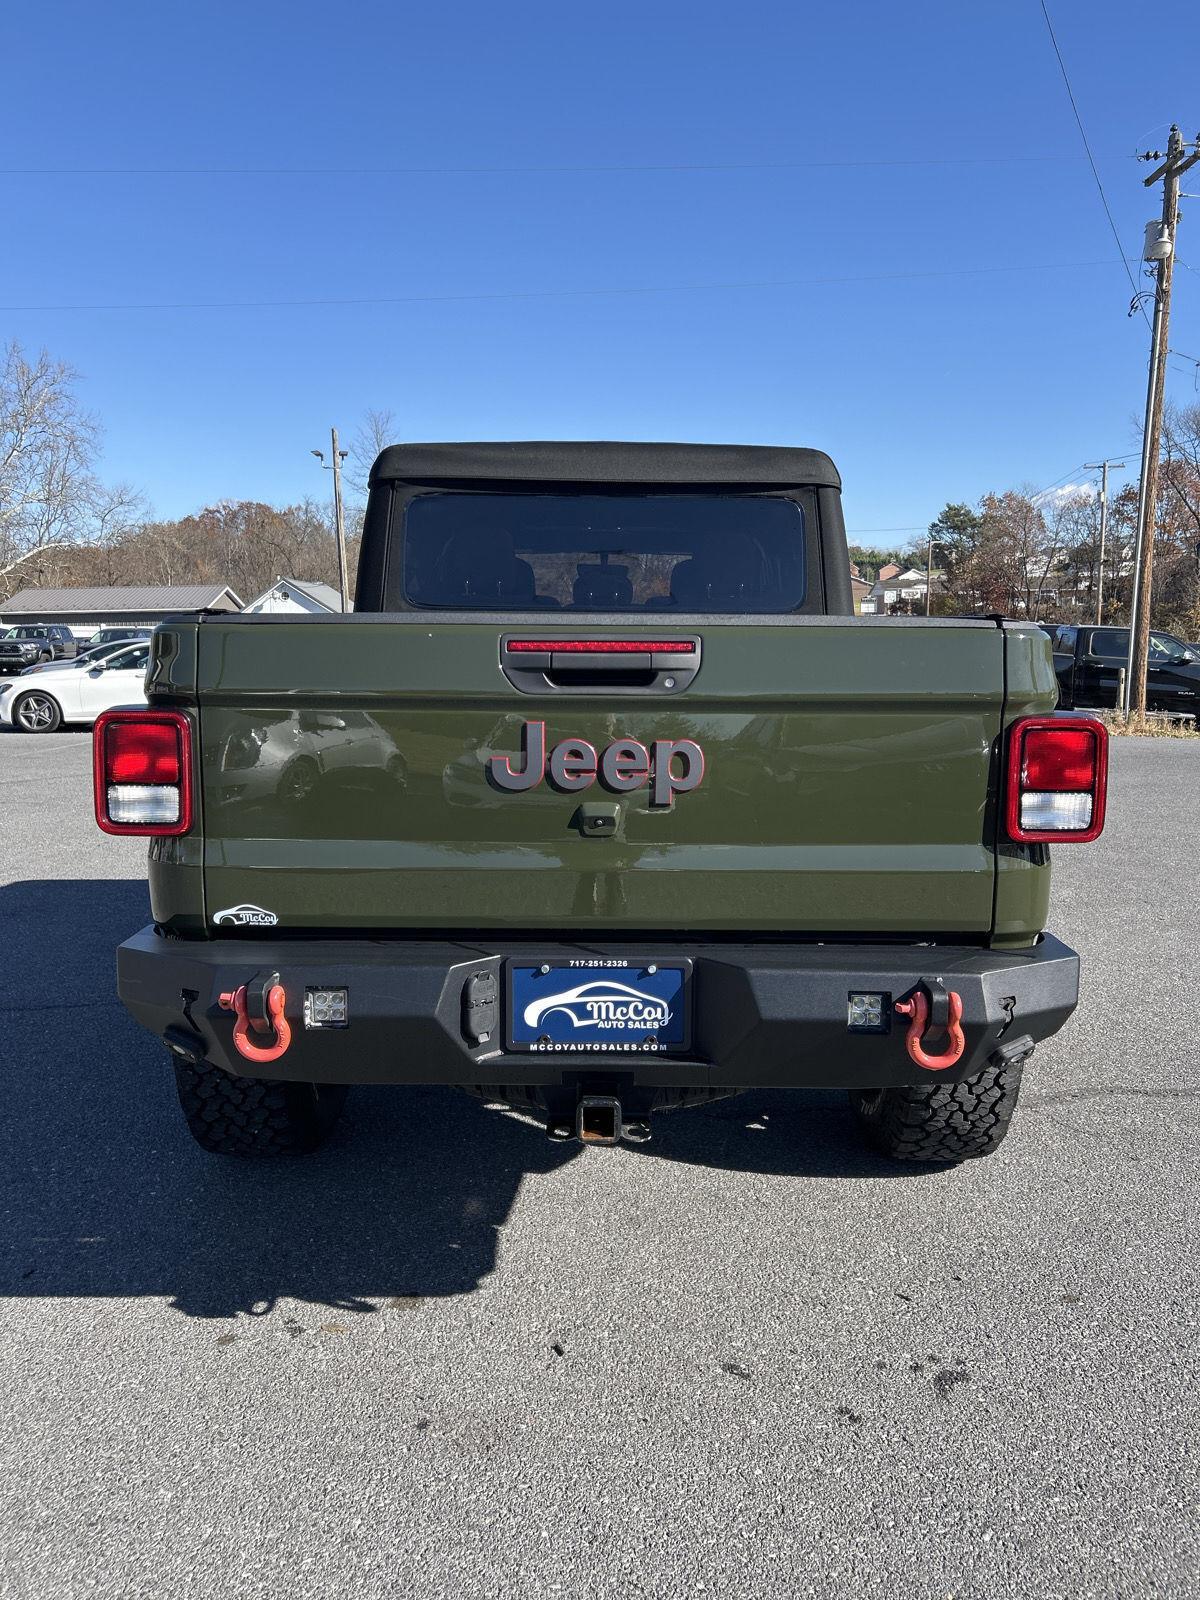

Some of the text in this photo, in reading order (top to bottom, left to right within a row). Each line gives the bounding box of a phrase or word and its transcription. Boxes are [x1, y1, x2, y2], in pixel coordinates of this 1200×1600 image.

[489, 720, 705, 806] Jeep
[239, 913, 279, 925] McCoy
[586, 1001, 673, 1026] McCoy
[597, 1021, 659, 1029] AUTO SALES
[529, 1043, 667, 1051] MCCOYAUTOSALES.COM
